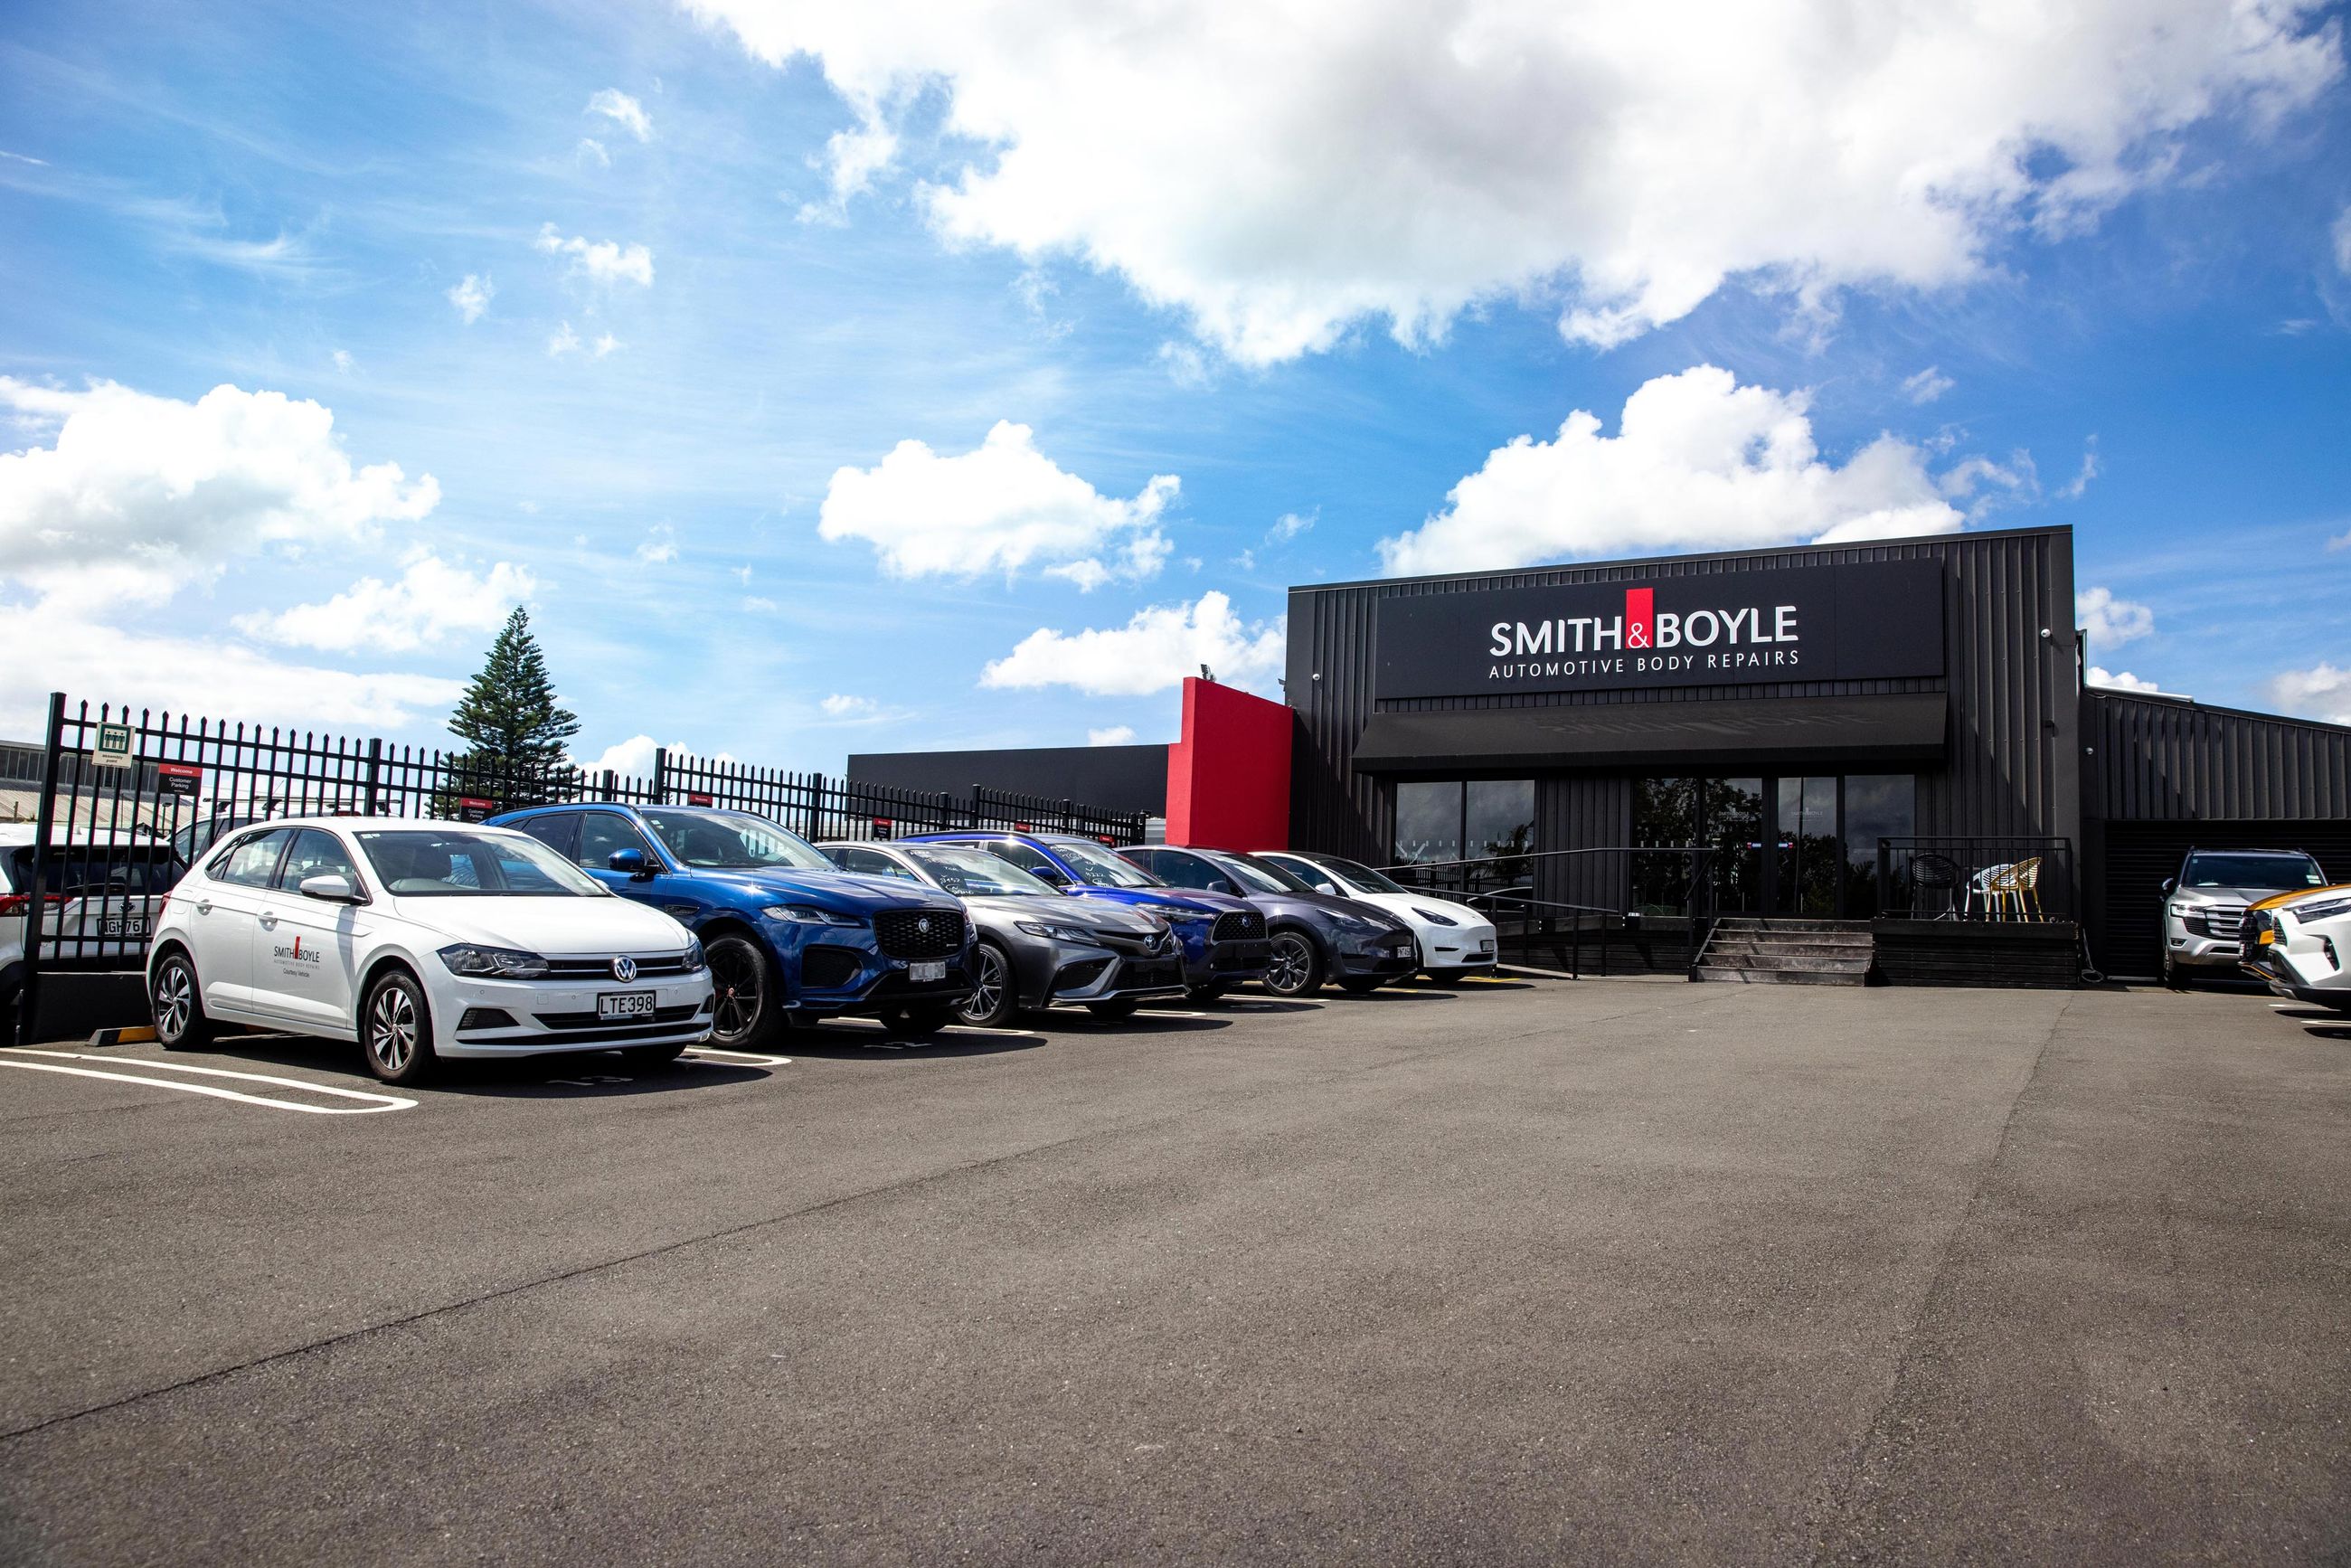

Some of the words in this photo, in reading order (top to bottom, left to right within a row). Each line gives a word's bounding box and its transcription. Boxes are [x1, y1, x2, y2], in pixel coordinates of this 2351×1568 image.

[1489, 658, 1624, 679] AUTOMOTIVE
[1638, 655, 1694, 672] BODY
[1707, 650, 1799, 668] REPAIRS
[170, 767, 194, 775] Welcome
[169, 777, 193, 785] Customer
[274, 946, 295, 959] SMITH
[298, 949, 320, 963] BOYLE
[600, 996, 653, 1014] LTE398
